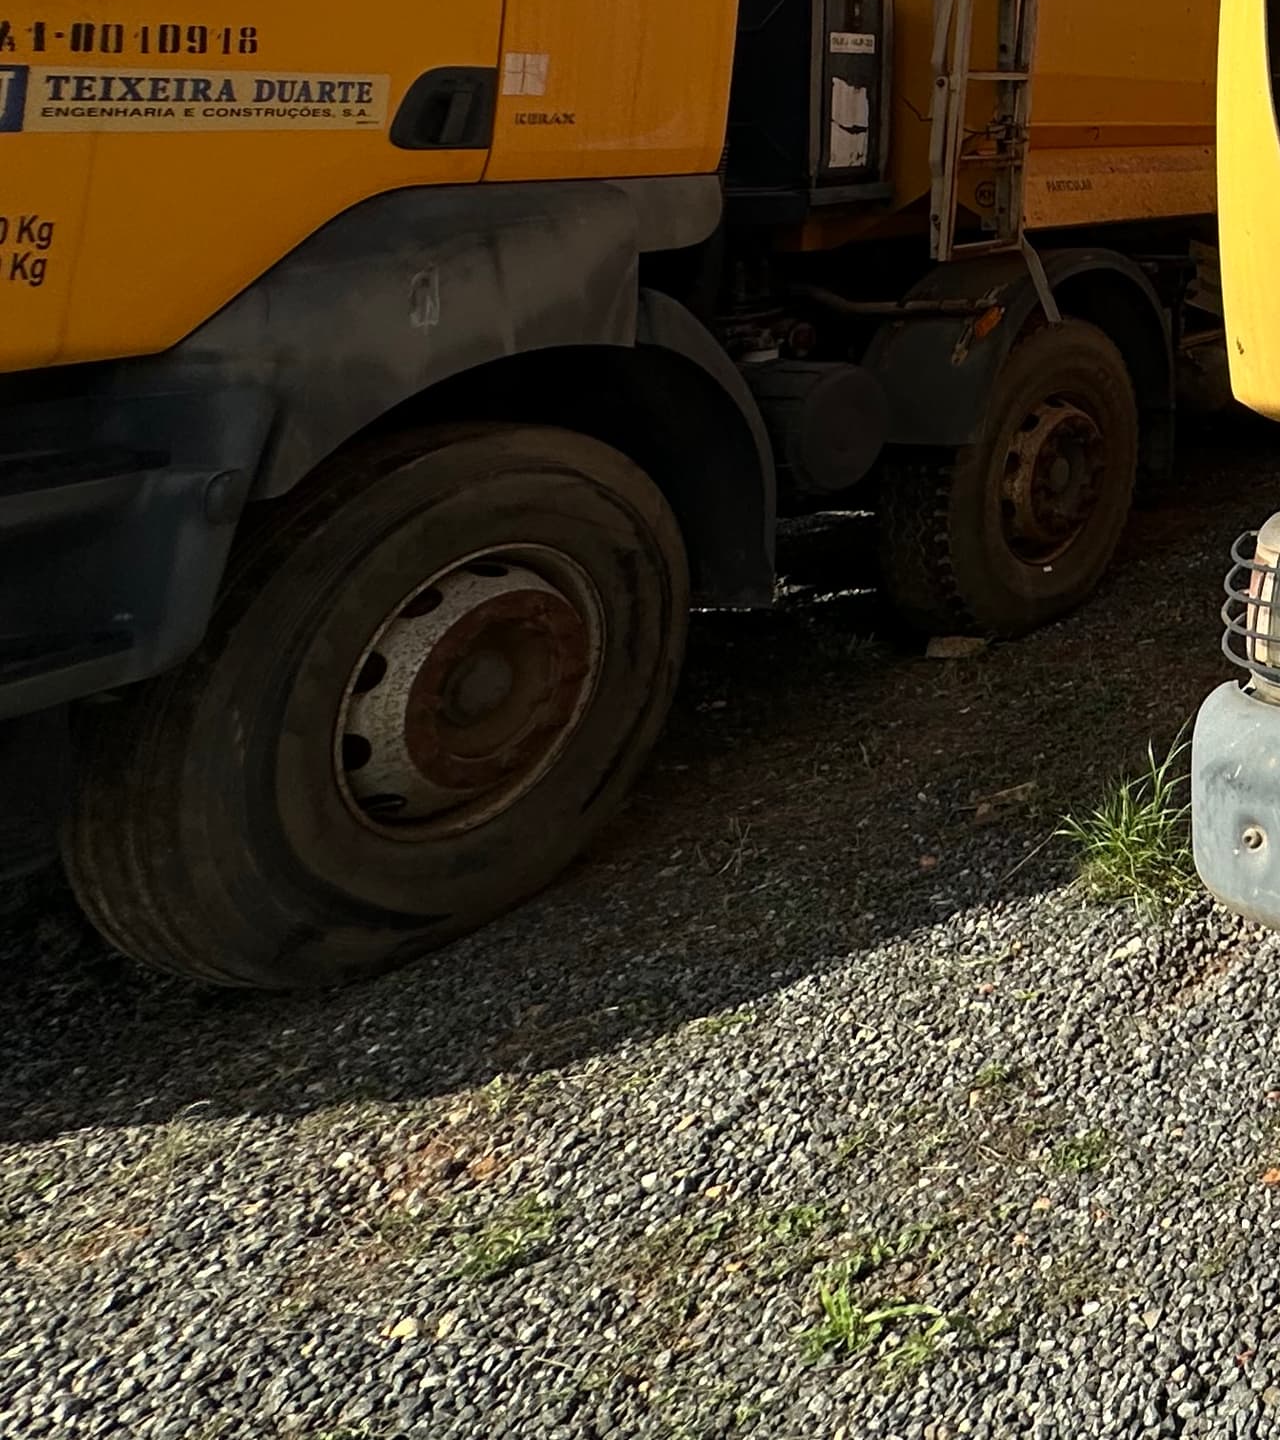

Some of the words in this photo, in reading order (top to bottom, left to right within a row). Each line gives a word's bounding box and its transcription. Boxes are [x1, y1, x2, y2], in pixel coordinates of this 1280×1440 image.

[45, 75, 237, 102] TEIXEIRA
[251, 79, 373, 104] DUARTE
[40, 106, 175, 118] ENGENHARIA
[183, 107, 196, 118] E
[16, 214, 56, 250] Kg
[9, 252, 48, 288] Kg
